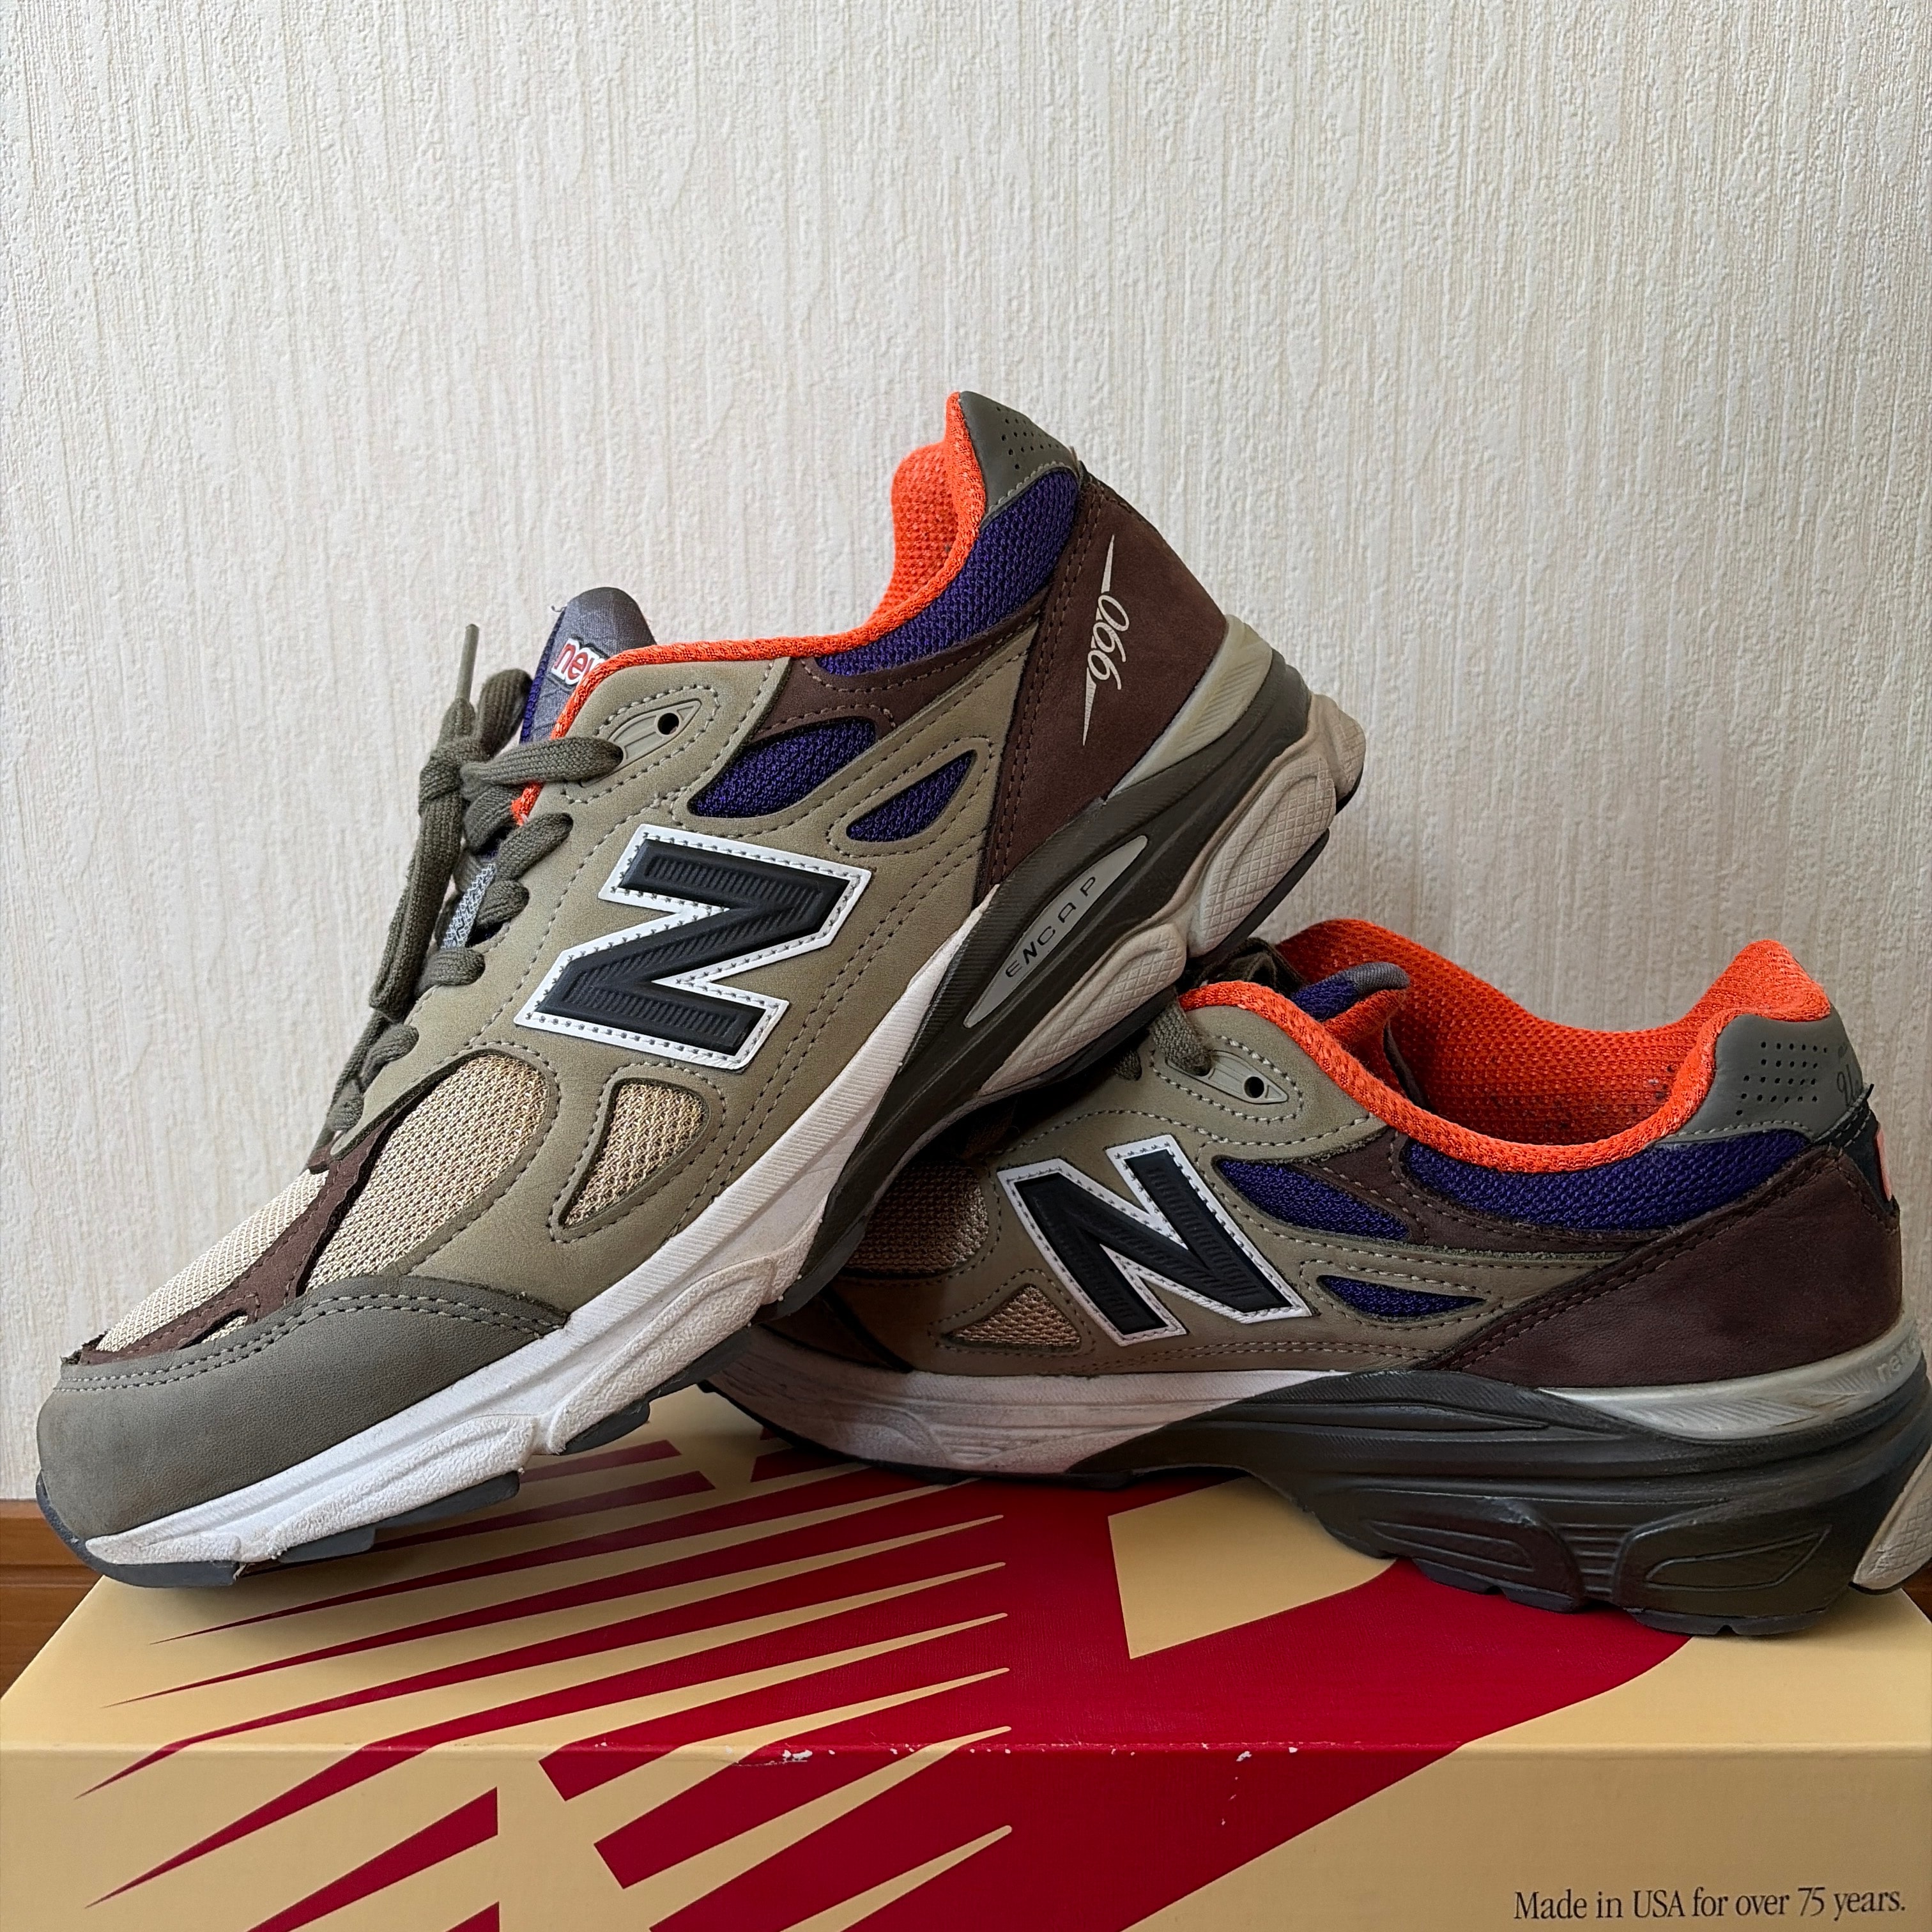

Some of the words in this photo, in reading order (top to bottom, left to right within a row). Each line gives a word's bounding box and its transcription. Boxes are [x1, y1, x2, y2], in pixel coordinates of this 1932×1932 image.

[1087, 595, 1130, 690] 990
[514, 824, 871, 1070] N
[1005, 876, 1096, 978] ENCAP
[997, 1135, 1312, 1346] N
[1514, 1888, 1588, 1920] Made
[1595, 1890, 1623, 1919] in
[1633, 1889, 1686, 1919] USA
[1691, 1886, 1729, 1917] for
[1735, 1894, 1790, 1916] over
[1797, 1886, 1826, 1917] 75
[1833, 1889, 1906, 1922] years.
